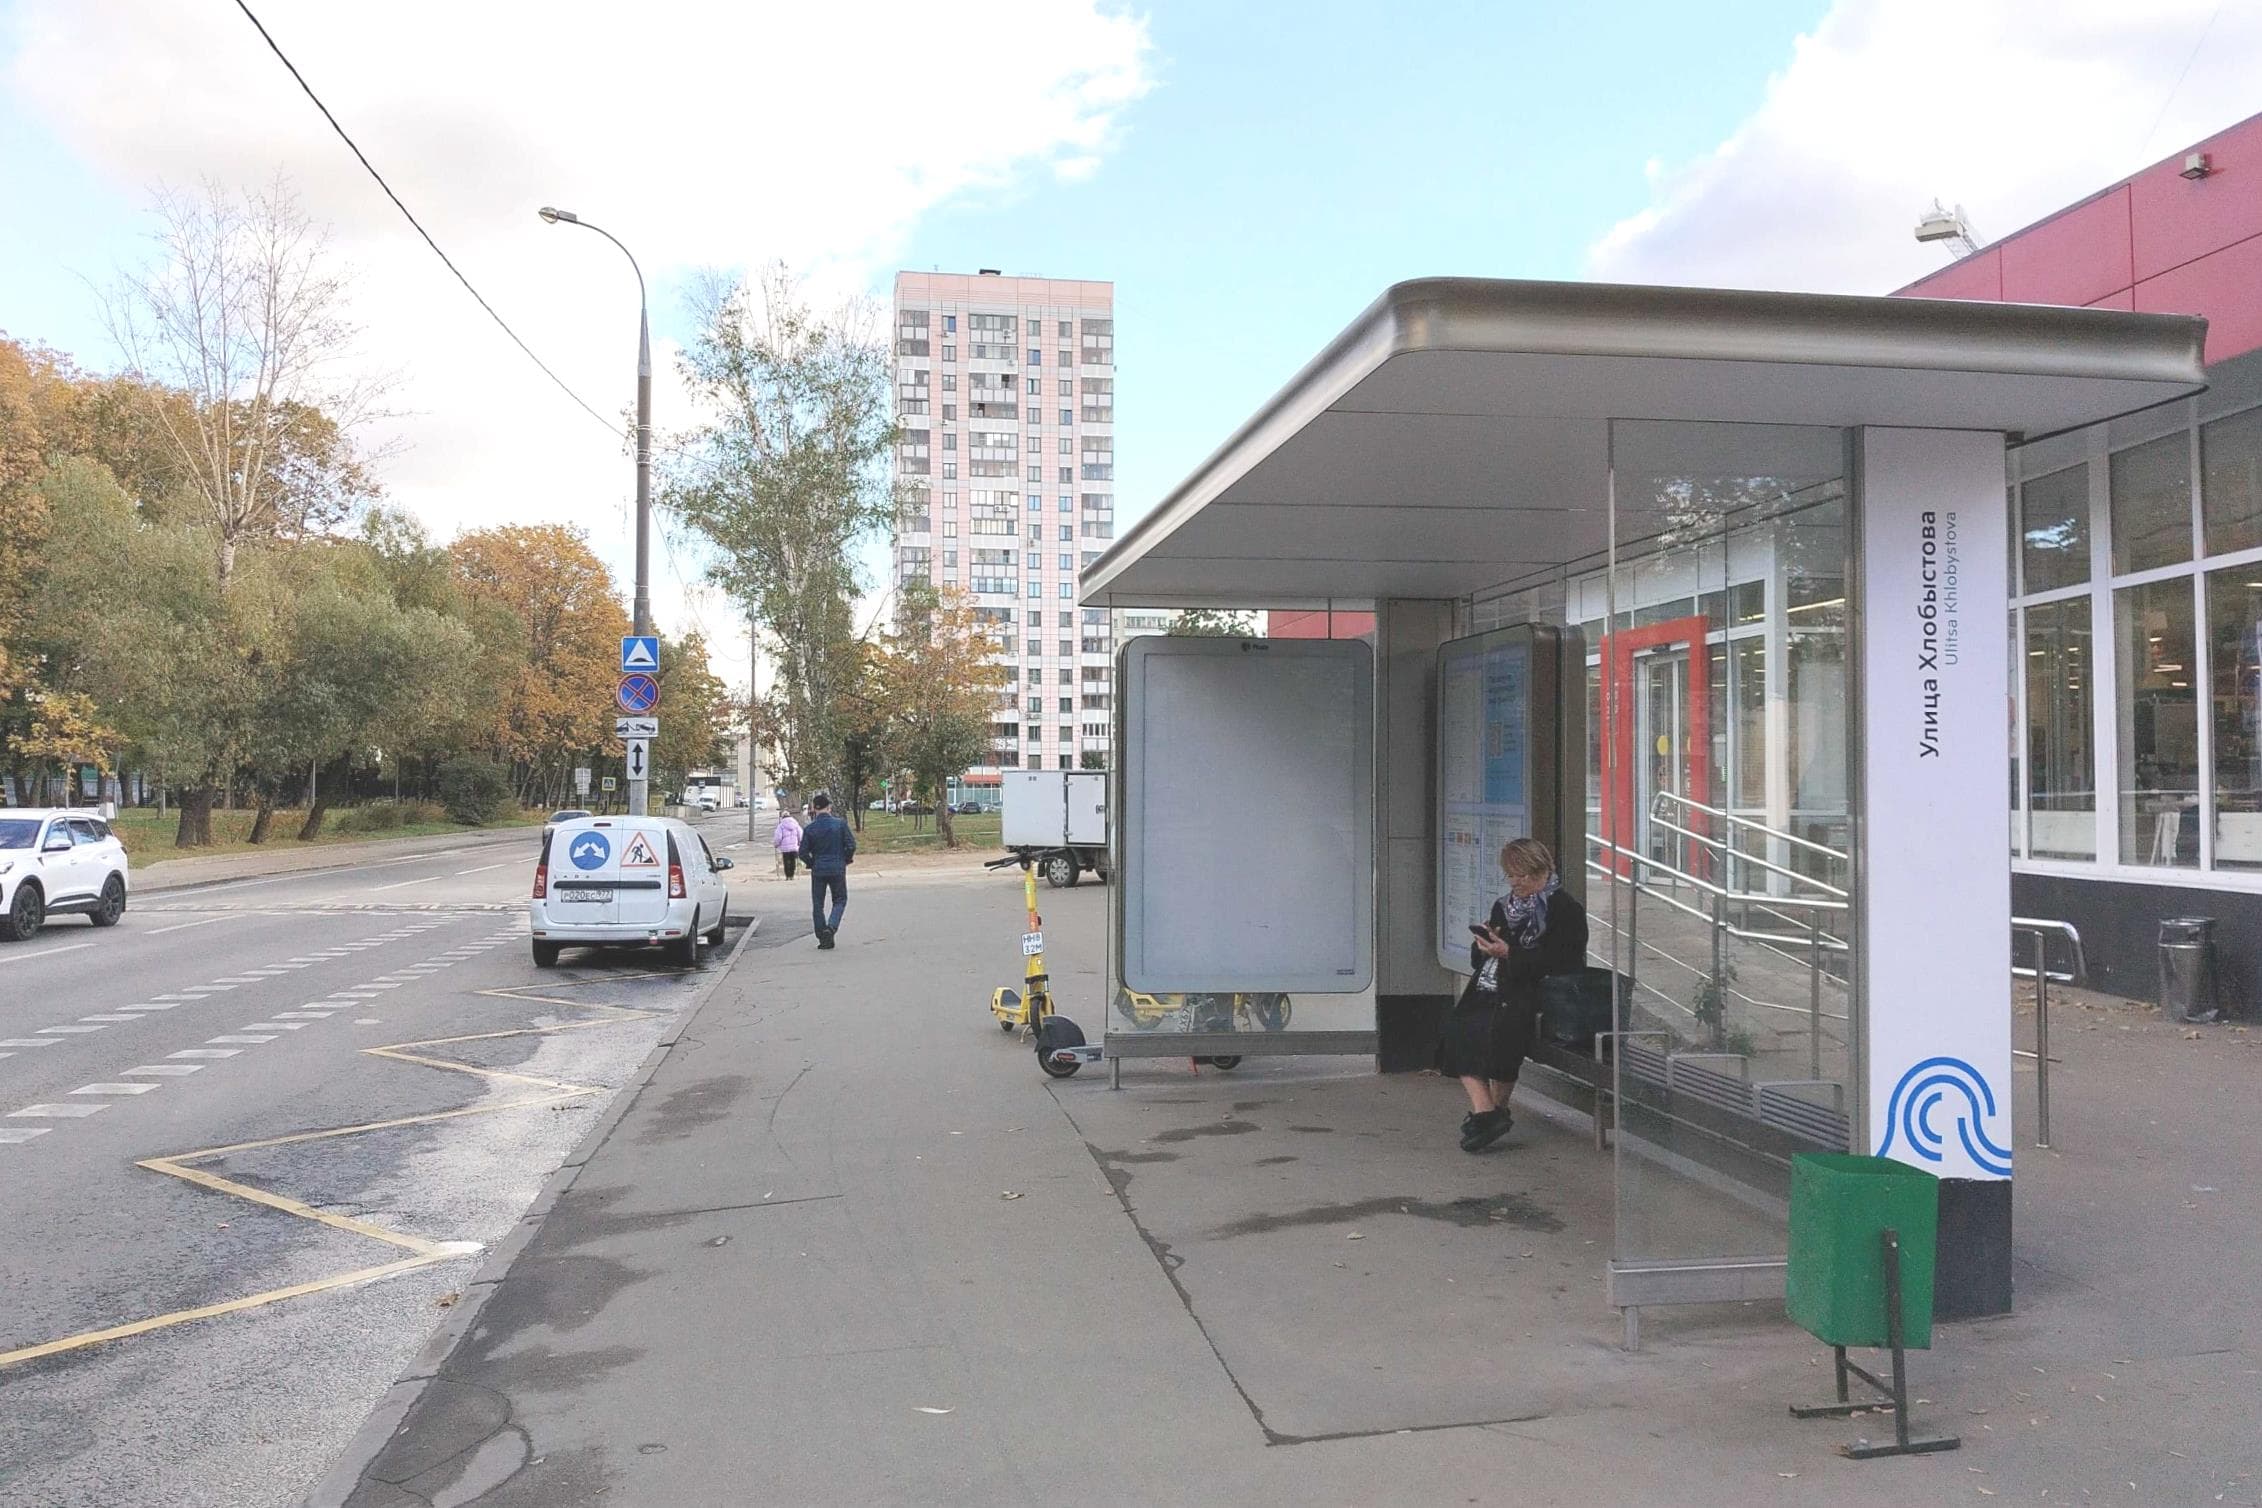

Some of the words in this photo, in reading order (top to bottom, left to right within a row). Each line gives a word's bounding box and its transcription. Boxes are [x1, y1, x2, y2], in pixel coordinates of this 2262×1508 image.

[1917, 511, 1938, 671] Хлобыстова
[1943, 511, 1960, 614] Khlobystova
[1944, 618, 1958, 666] Ulitsa
[1919, 678, 1941, 758] Улица
